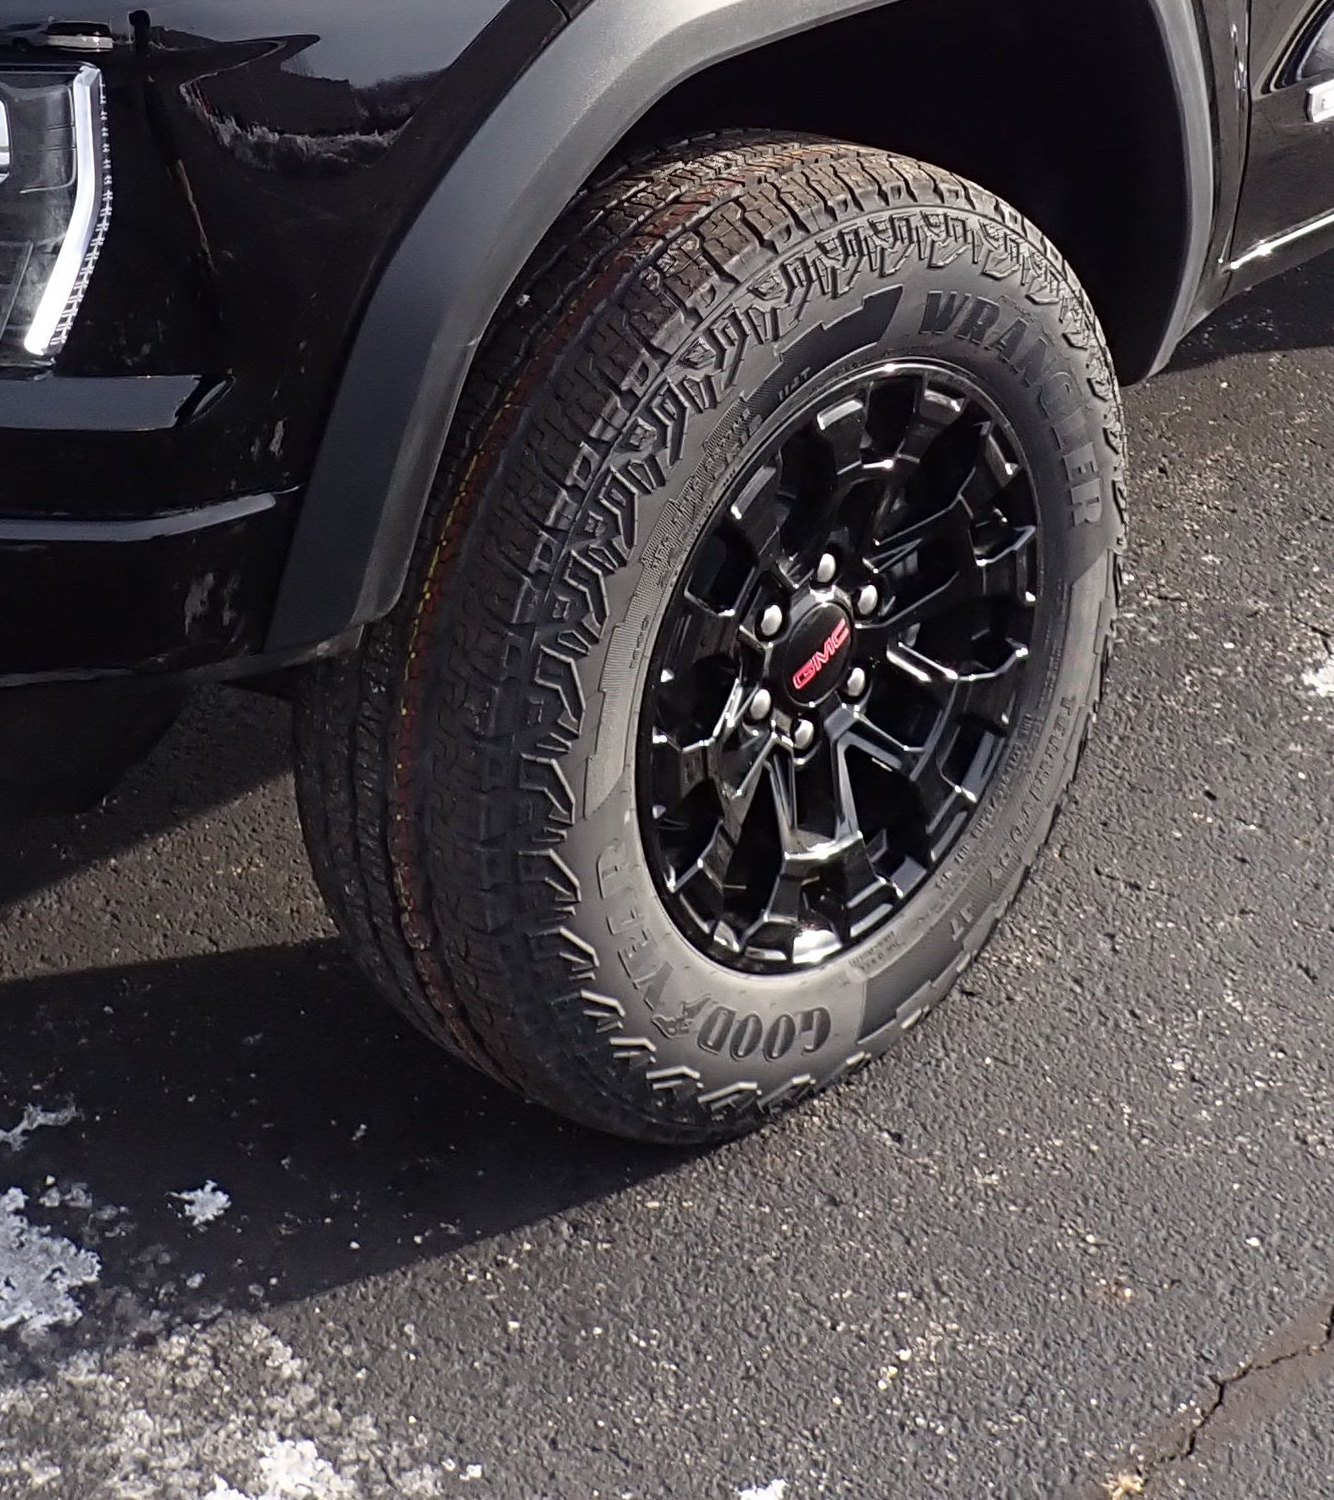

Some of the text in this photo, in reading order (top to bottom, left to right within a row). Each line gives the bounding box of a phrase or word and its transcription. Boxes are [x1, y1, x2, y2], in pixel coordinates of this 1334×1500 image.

[918, 289, 1103, 528] WRANGLER
[792, 617, 849, 689] GMC
[596, 837, 832, 1062] GOODYEAR
